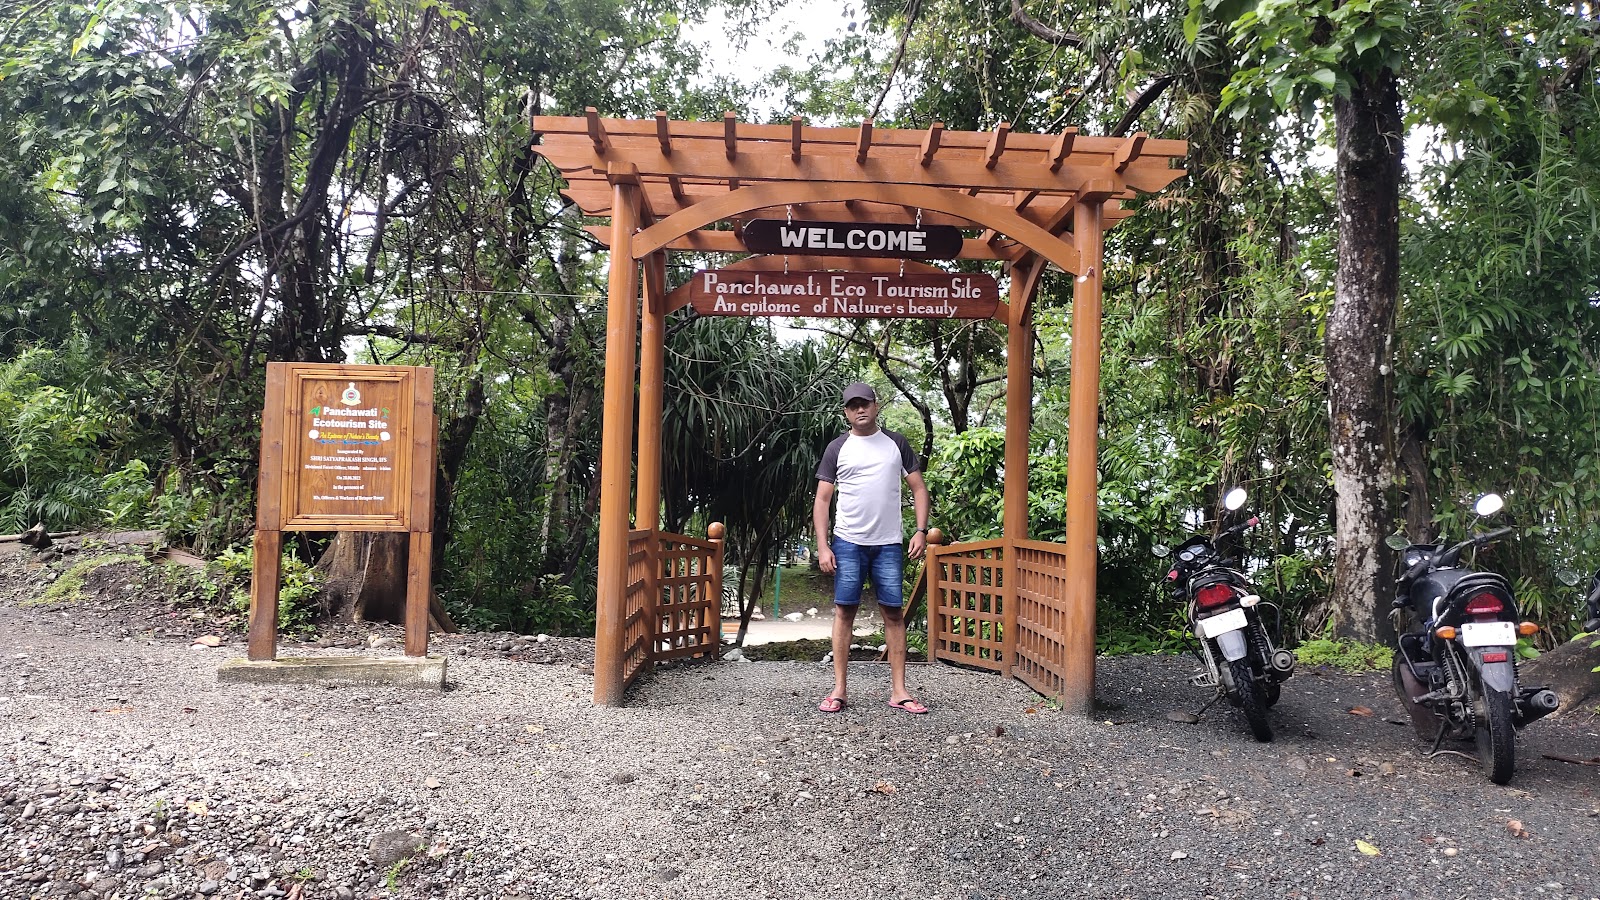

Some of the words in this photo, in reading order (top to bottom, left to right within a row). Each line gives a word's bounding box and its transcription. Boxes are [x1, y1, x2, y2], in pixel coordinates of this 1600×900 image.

[780, 226, 927, 252] WELCOME
[703, 272, 821, 296] Panchawati
[830, 275, 867, 297] Eco
[871, 276, 948, 298] Tourism
[713, 294, 737, 312] An
[813, 297, 829, 313] of
[833, 297, 905, 315] Nature's
[908, 298, 958, 318] beauty
[313, 417, 367, 429] Ecotourism
[368, 419, 388, 429] Site
[323, 406, 378, 417] Panchawati
